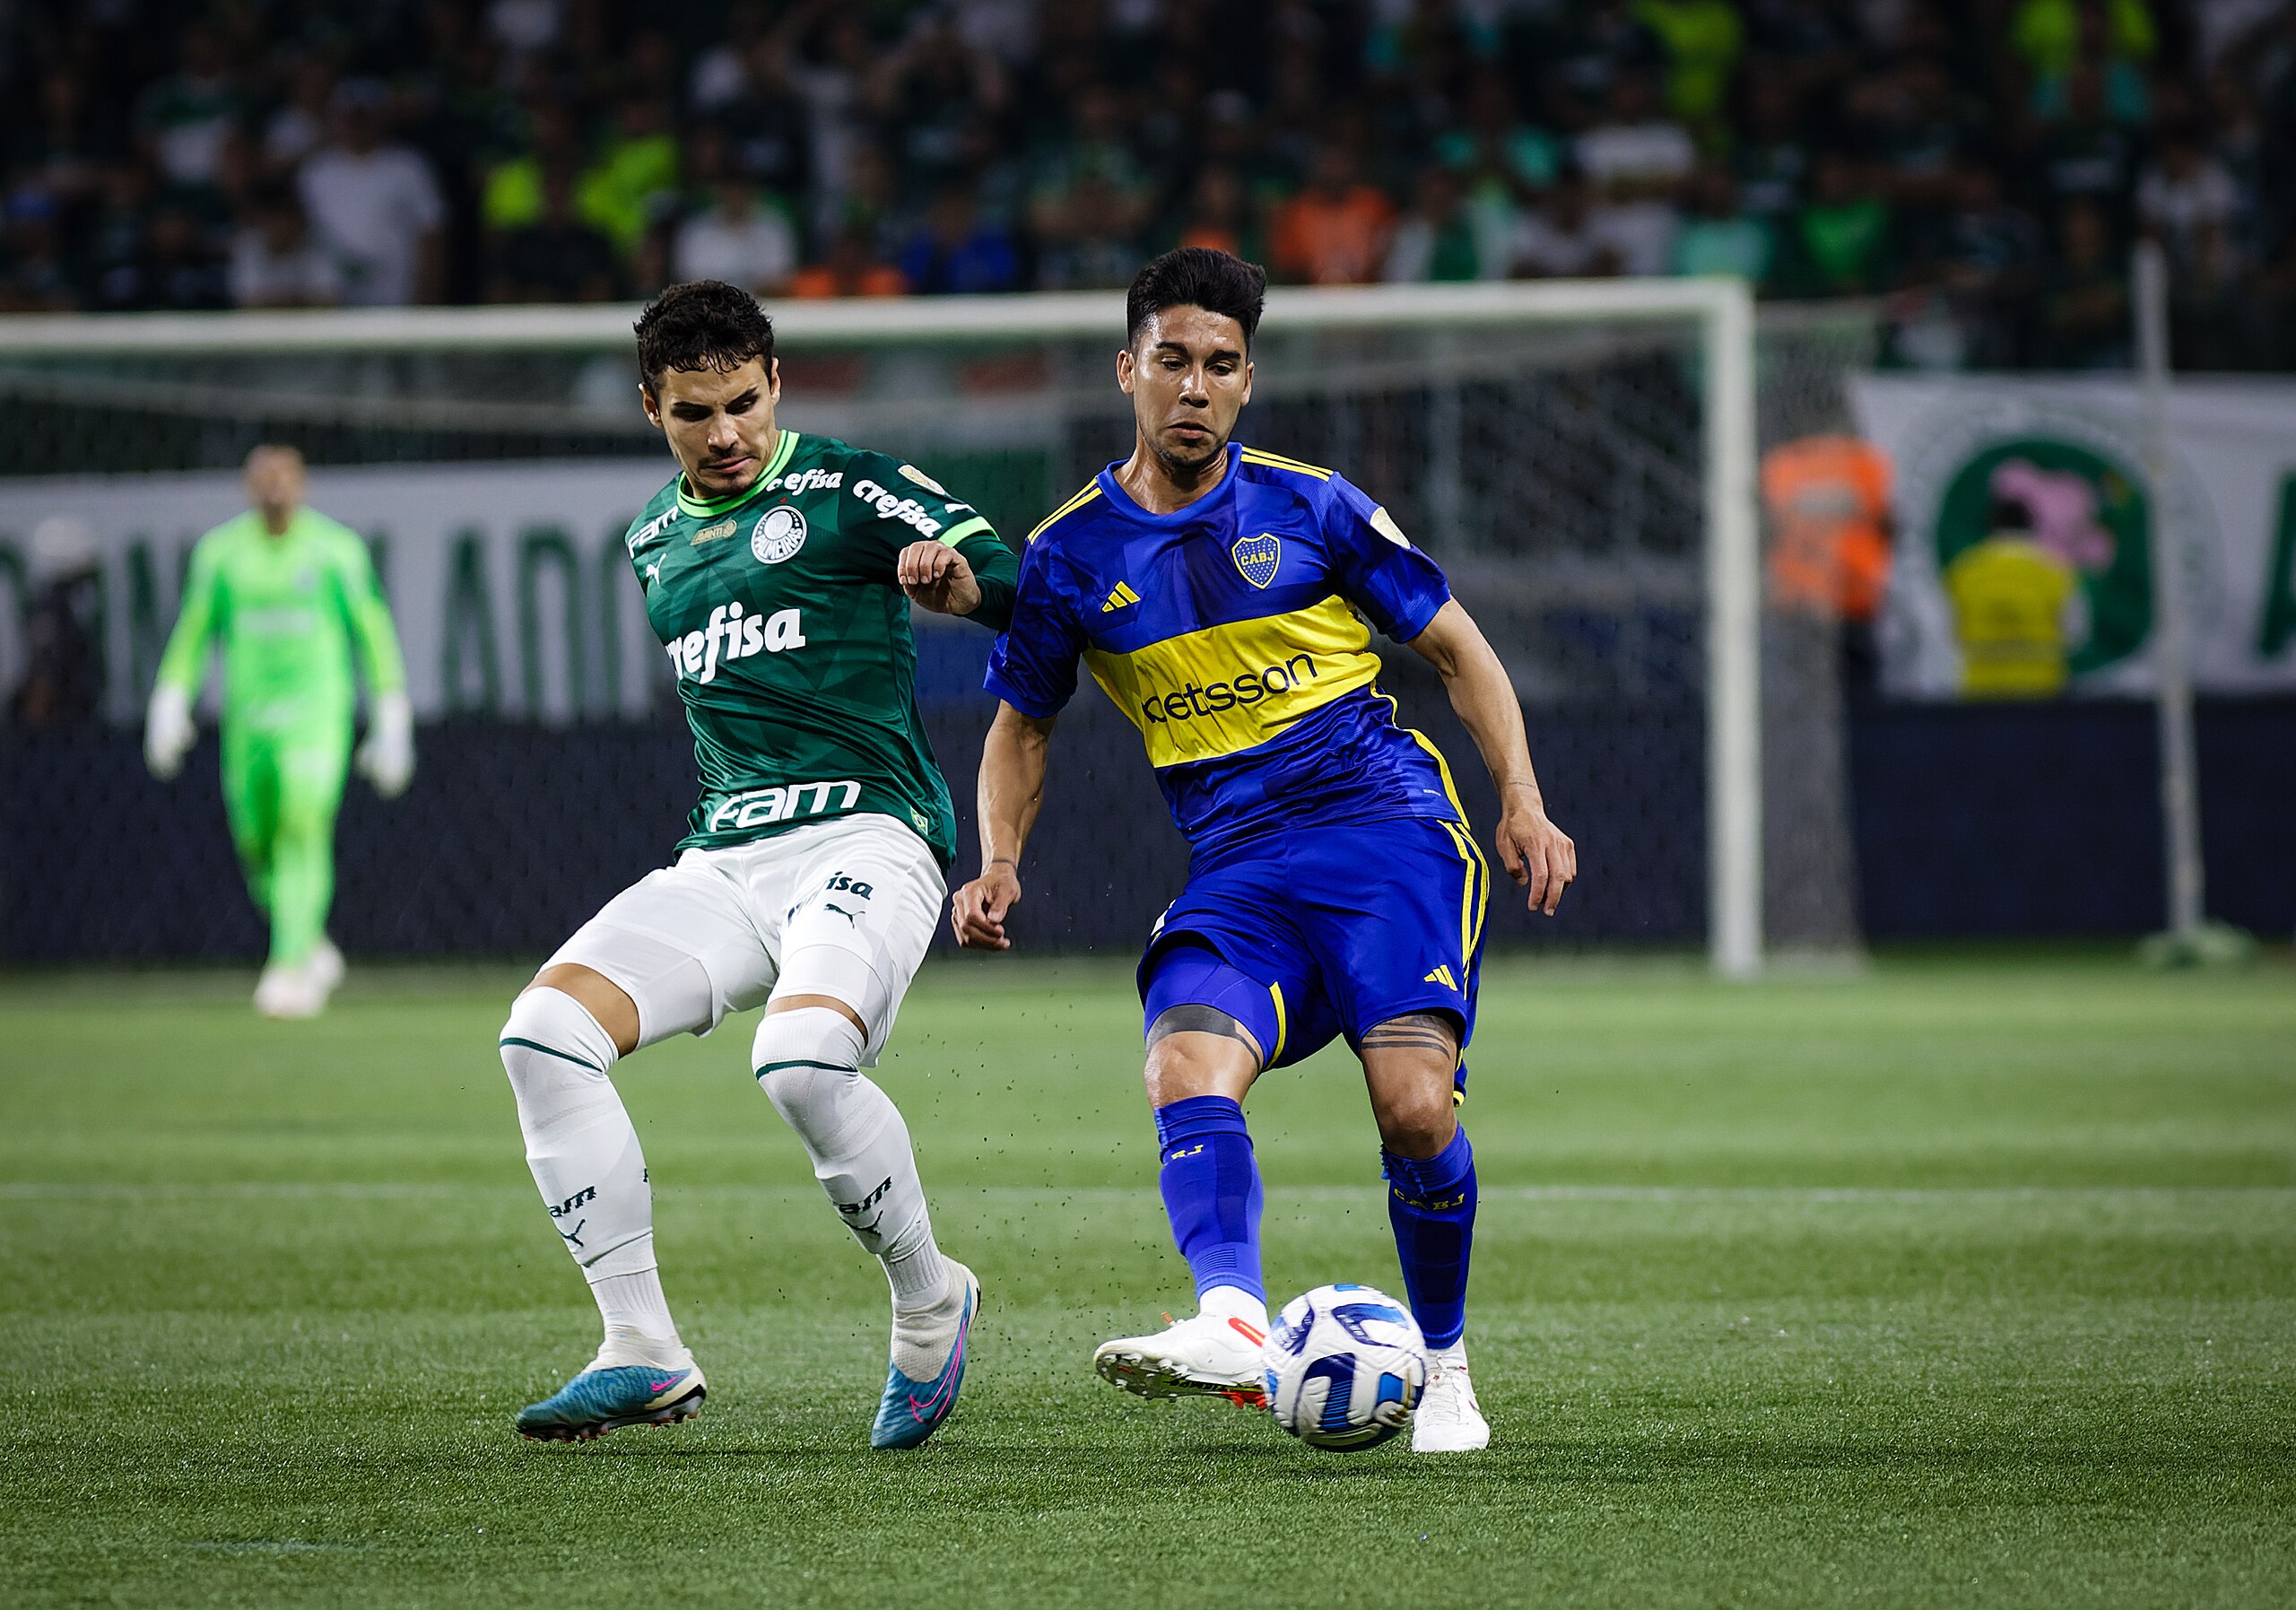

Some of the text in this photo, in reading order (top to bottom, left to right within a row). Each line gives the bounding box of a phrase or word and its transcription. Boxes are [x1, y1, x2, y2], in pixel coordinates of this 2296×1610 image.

[852, 479, 943, 538] crefisa
[1240, 551, 1274, 566] CABJ
[665, 601, 806, 684] refisa
[548, 1185, 596, 1218] am
[833, 1175, 892, 1214] am
